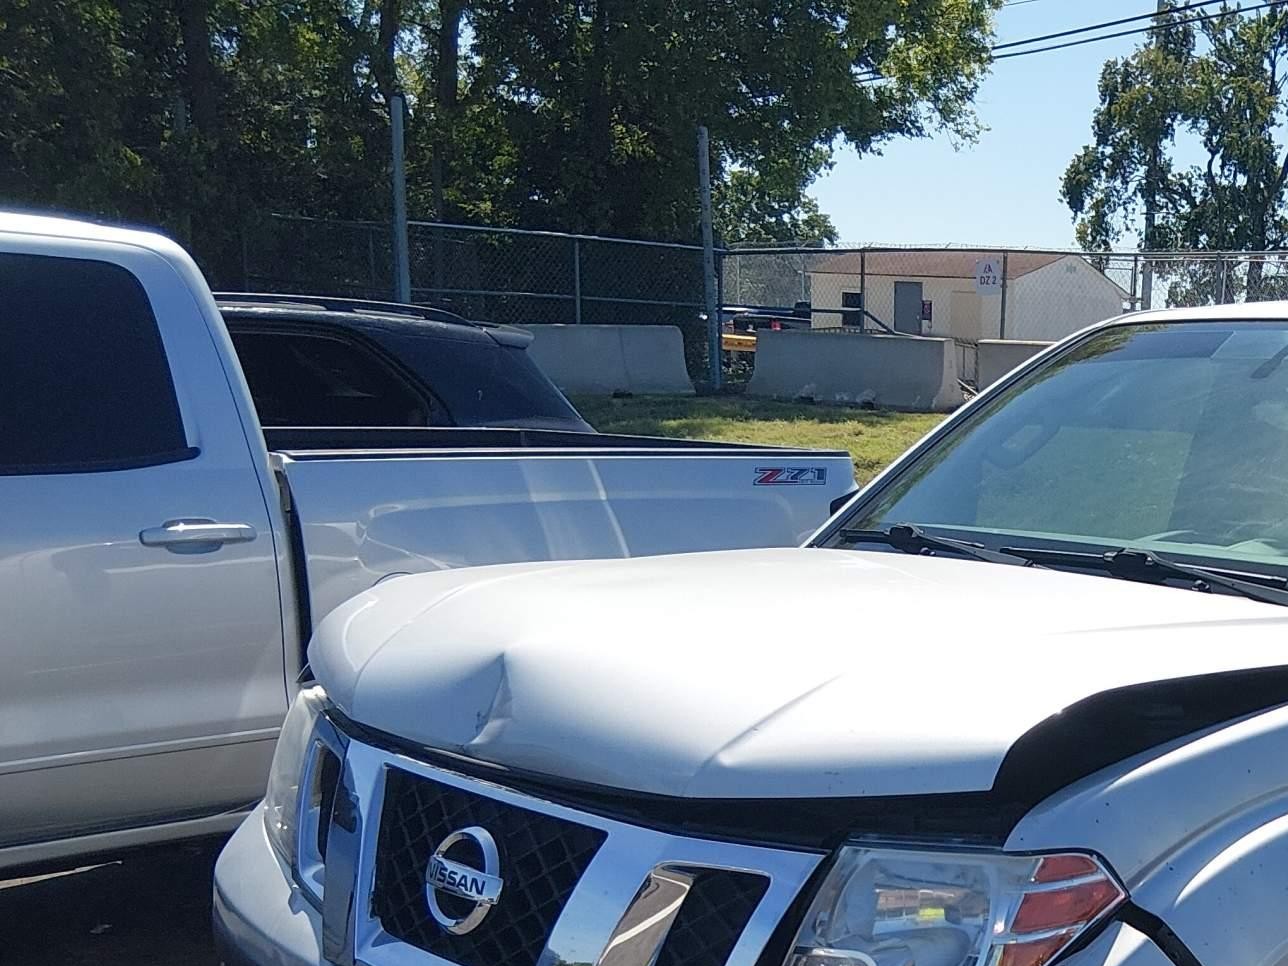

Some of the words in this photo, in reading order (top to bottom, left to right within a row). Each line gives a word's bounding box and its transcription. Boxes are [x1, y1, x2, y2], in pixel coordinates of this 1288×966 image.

[979, 275, 991, 286] DZ
[991, 275, 997, 285] 2
[753, 467, 828, 486] Z71
[427, 861, 486, 896] NISSAN
